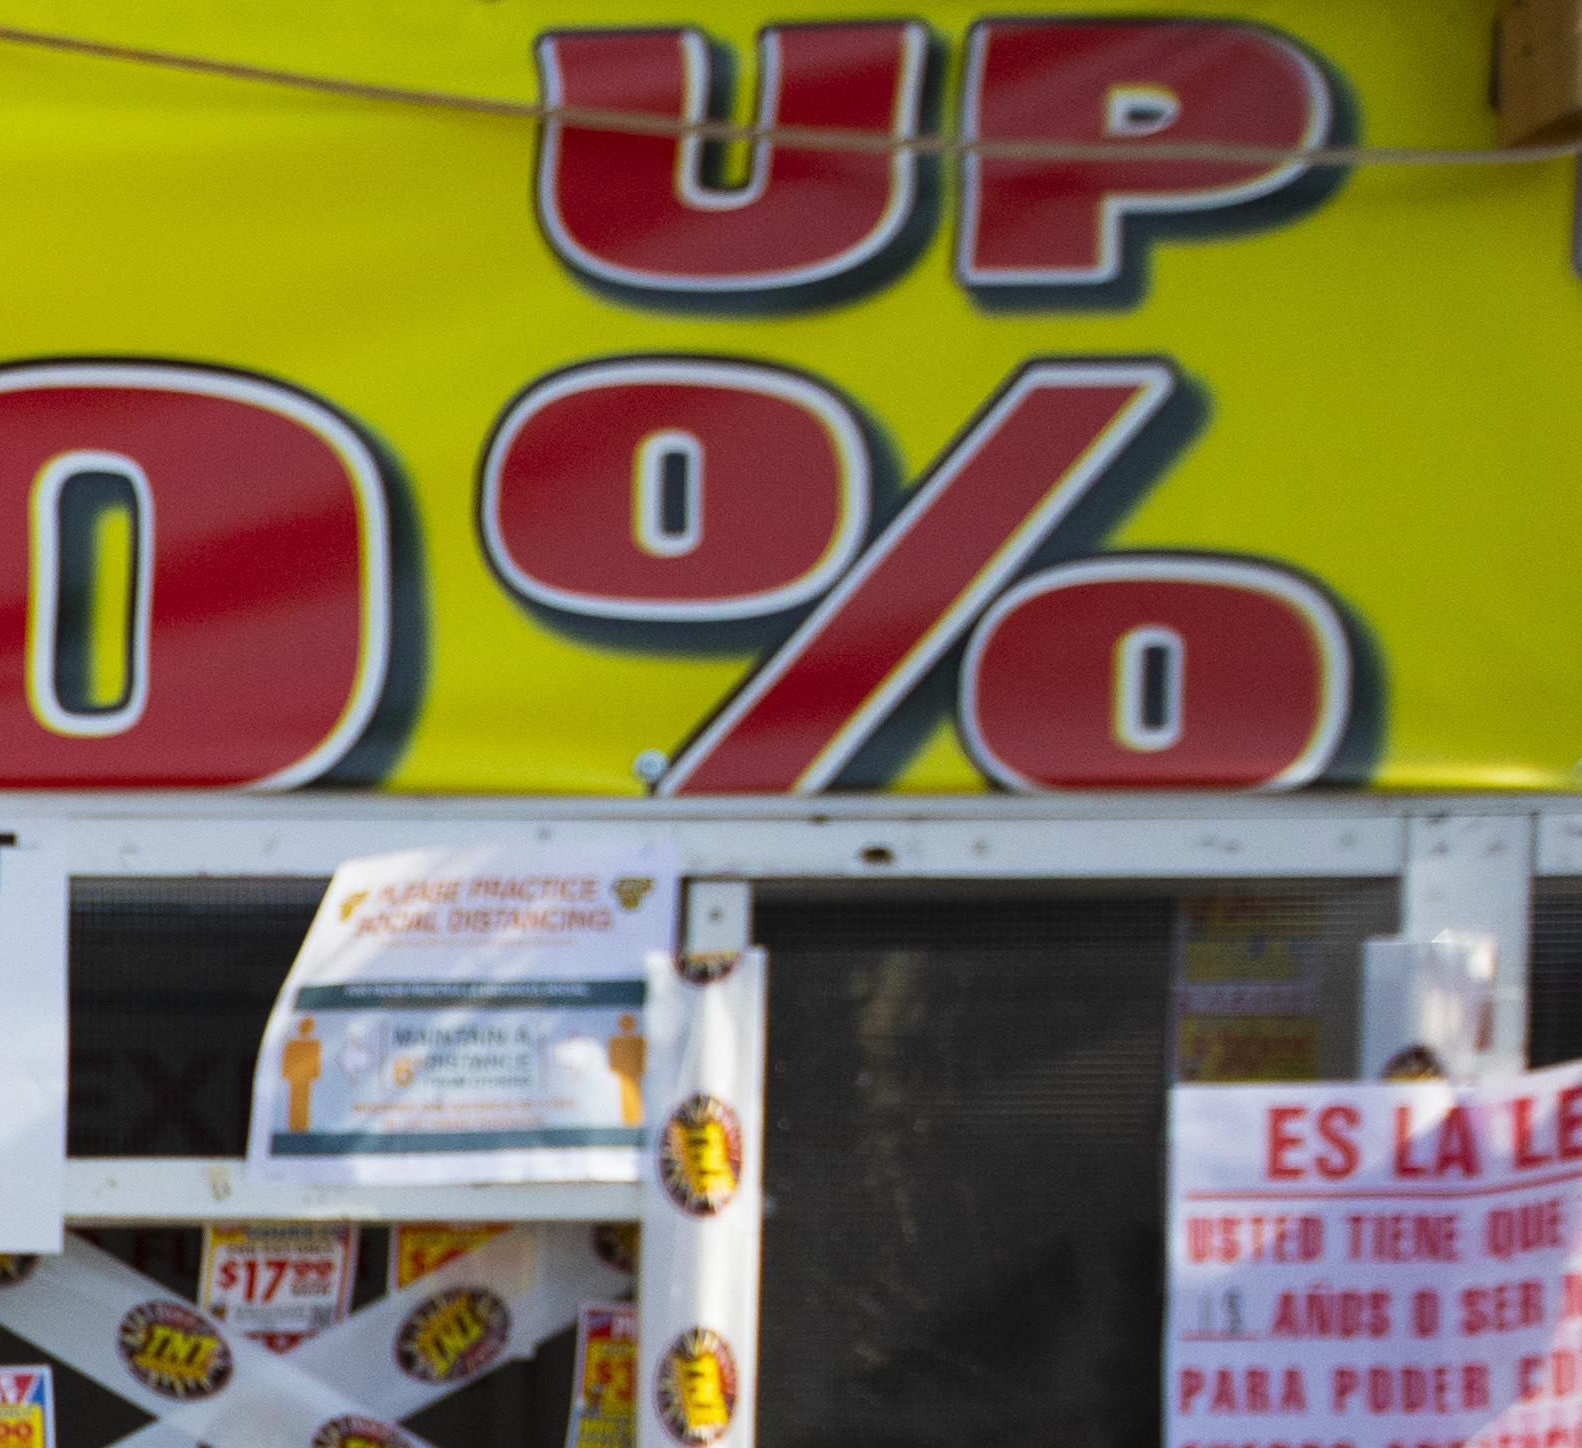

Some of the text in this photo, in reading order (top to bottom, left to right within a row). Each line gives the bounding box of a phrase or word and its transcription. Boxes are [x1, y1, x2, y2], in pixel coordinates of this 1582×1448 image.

[533, 20, 1339, 292] UP
[468, 875, 599, 902] PRACTICE
[353, 904, 615, 936] SOCIAL DISTANCING
[1266, 1085, 1582, 1181] ES LA LE
[1187, 1199, 1561, 1264] USTED TIENE QUE
[1269, 1279, 1391, 1338] AÑOS
[1459, 1278, 1545, 1337] SER
[1178, 1366, 1308, 1414] PARA
[1332, 1364, 1490, 1415] PODER
